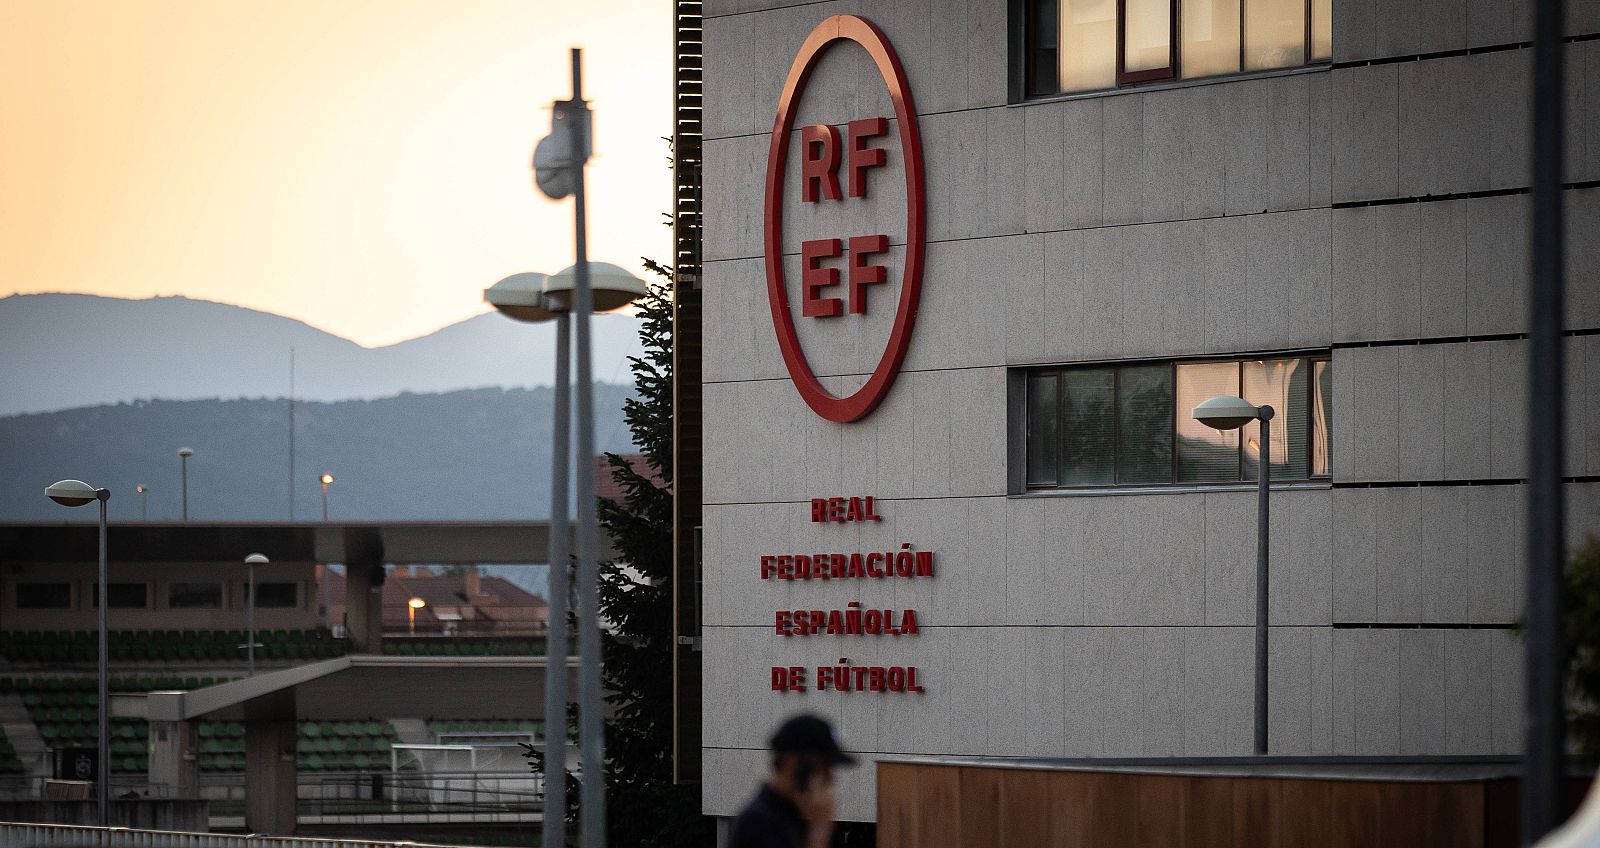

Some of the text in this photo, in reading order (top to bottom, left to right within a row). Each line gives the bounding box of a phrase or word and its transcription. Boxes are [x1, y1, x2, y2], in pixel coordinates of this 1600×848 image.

[811, 496, 881, 522] REAL
[760, 543, 934, 580] FEDERACIÓN
[775, 602, 918, 635] ESPAÑOLA
[771, 657, 924, 693] DE FÚTBOL
